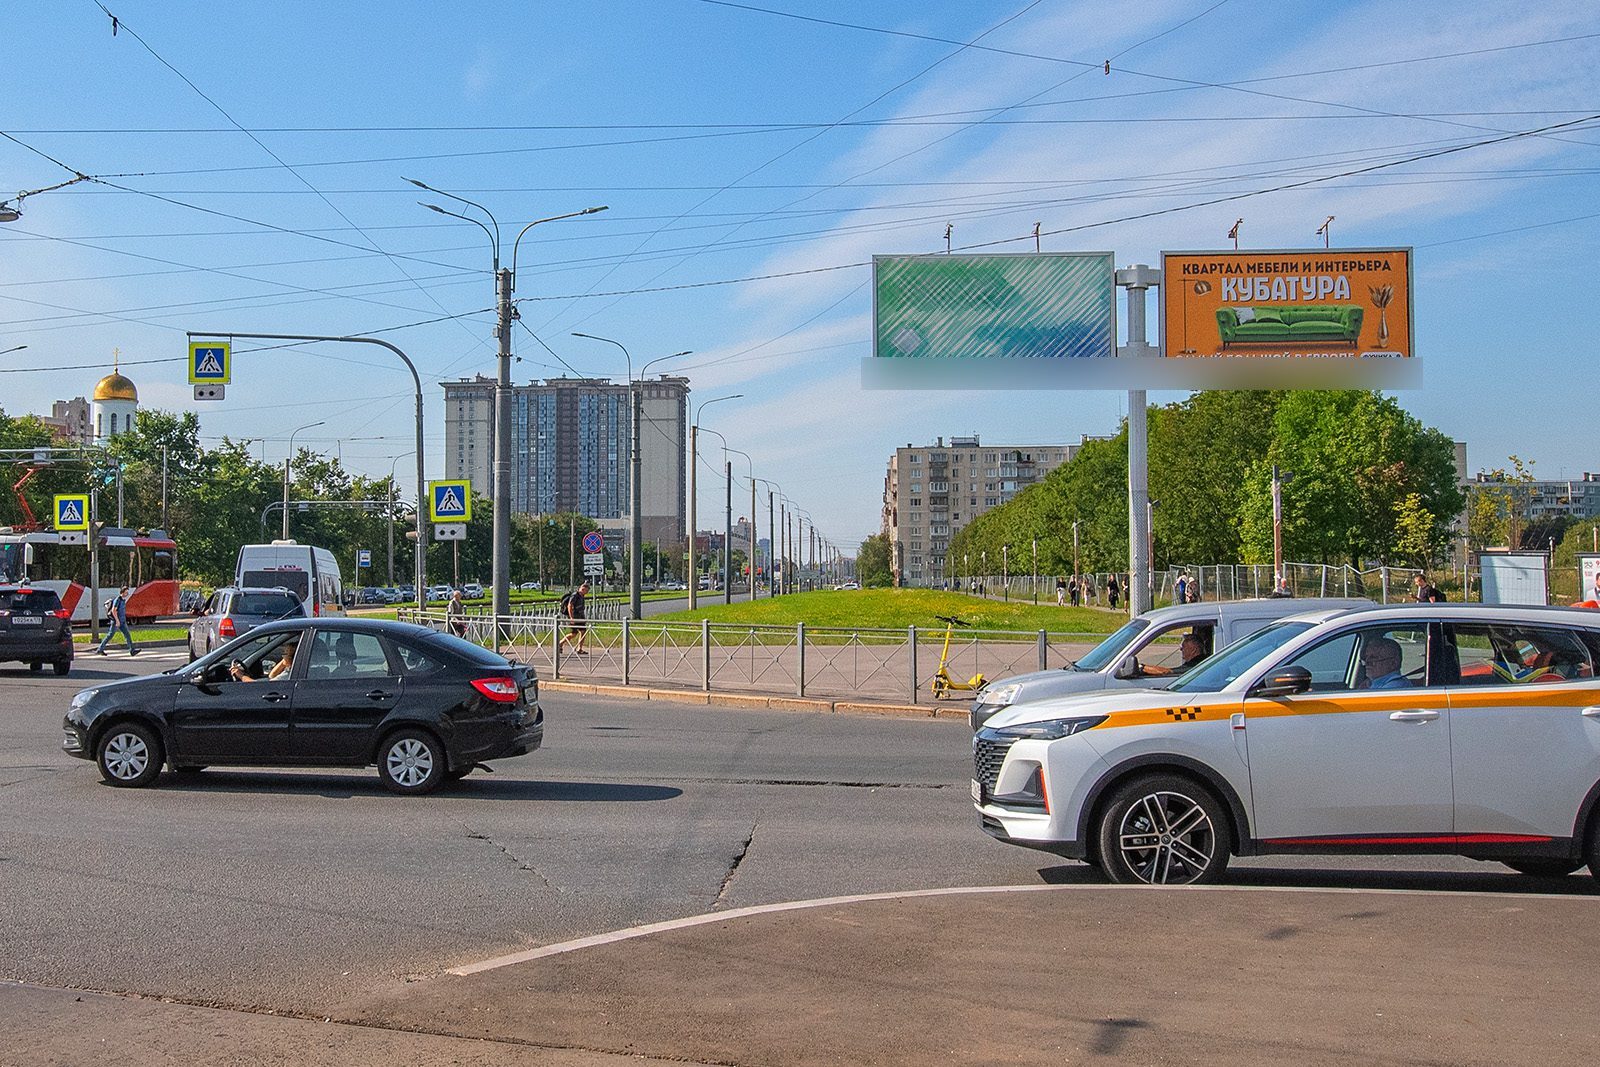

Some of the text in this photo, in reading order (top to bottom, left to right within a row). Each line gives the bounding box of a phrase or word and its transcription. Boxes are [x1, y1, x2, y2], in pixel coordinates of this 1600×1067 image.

[1183, 259, 1392, 275] КВАРТАЛ МЕБЕЛИ И ИНТЕРЬЕРА
[1221, 275, 1351, 302] КУБАТУРА
